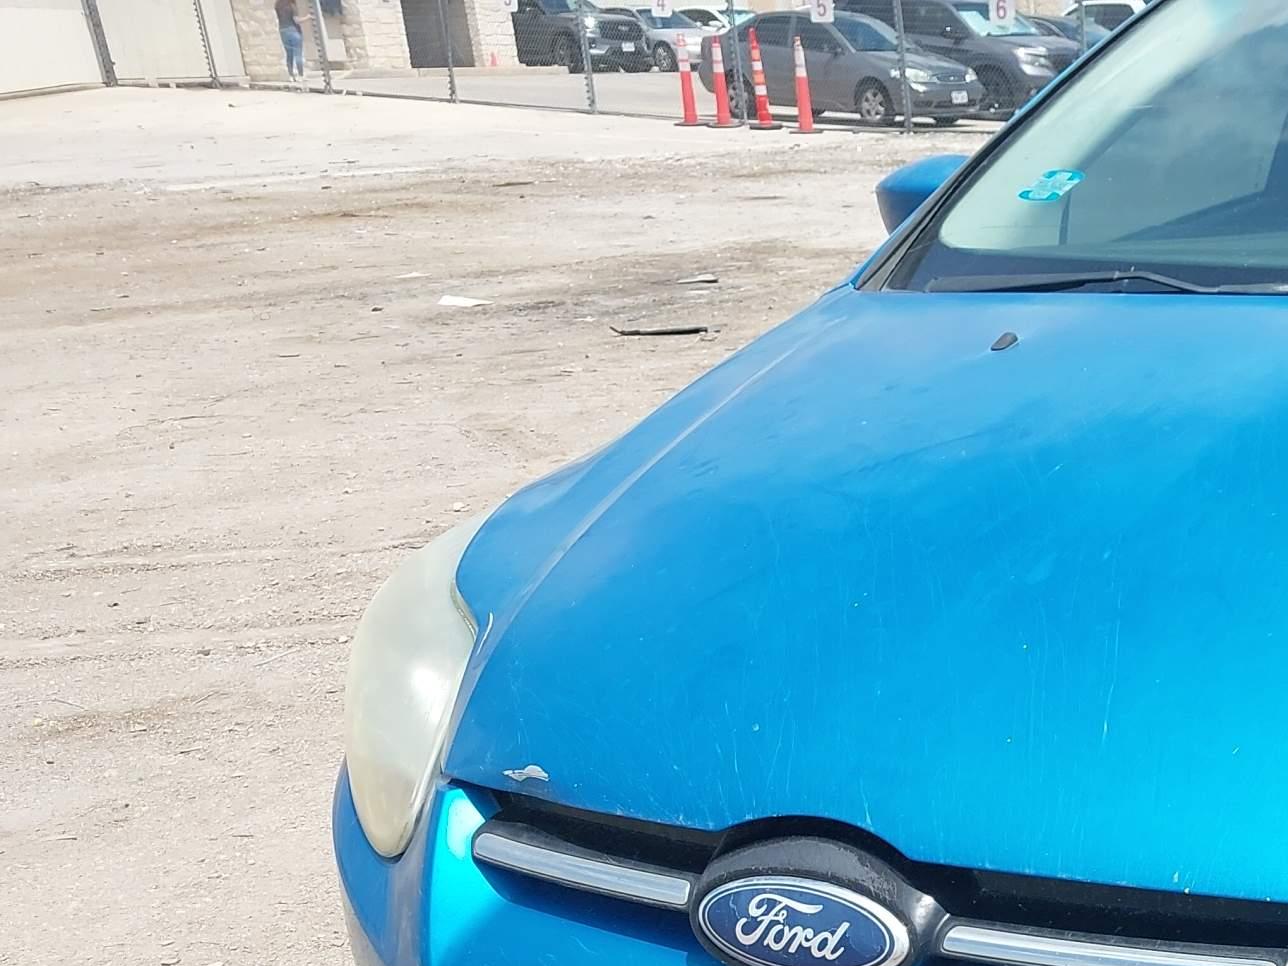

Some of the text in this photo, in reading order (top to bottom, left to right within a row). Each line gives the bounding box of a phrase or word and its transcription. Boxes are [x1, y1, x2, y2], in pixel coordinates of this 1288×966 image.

[817, 0, 827, 17] 5
[996, 0, 1007, 20] 6
[735, 892, 851, 961] Ford
